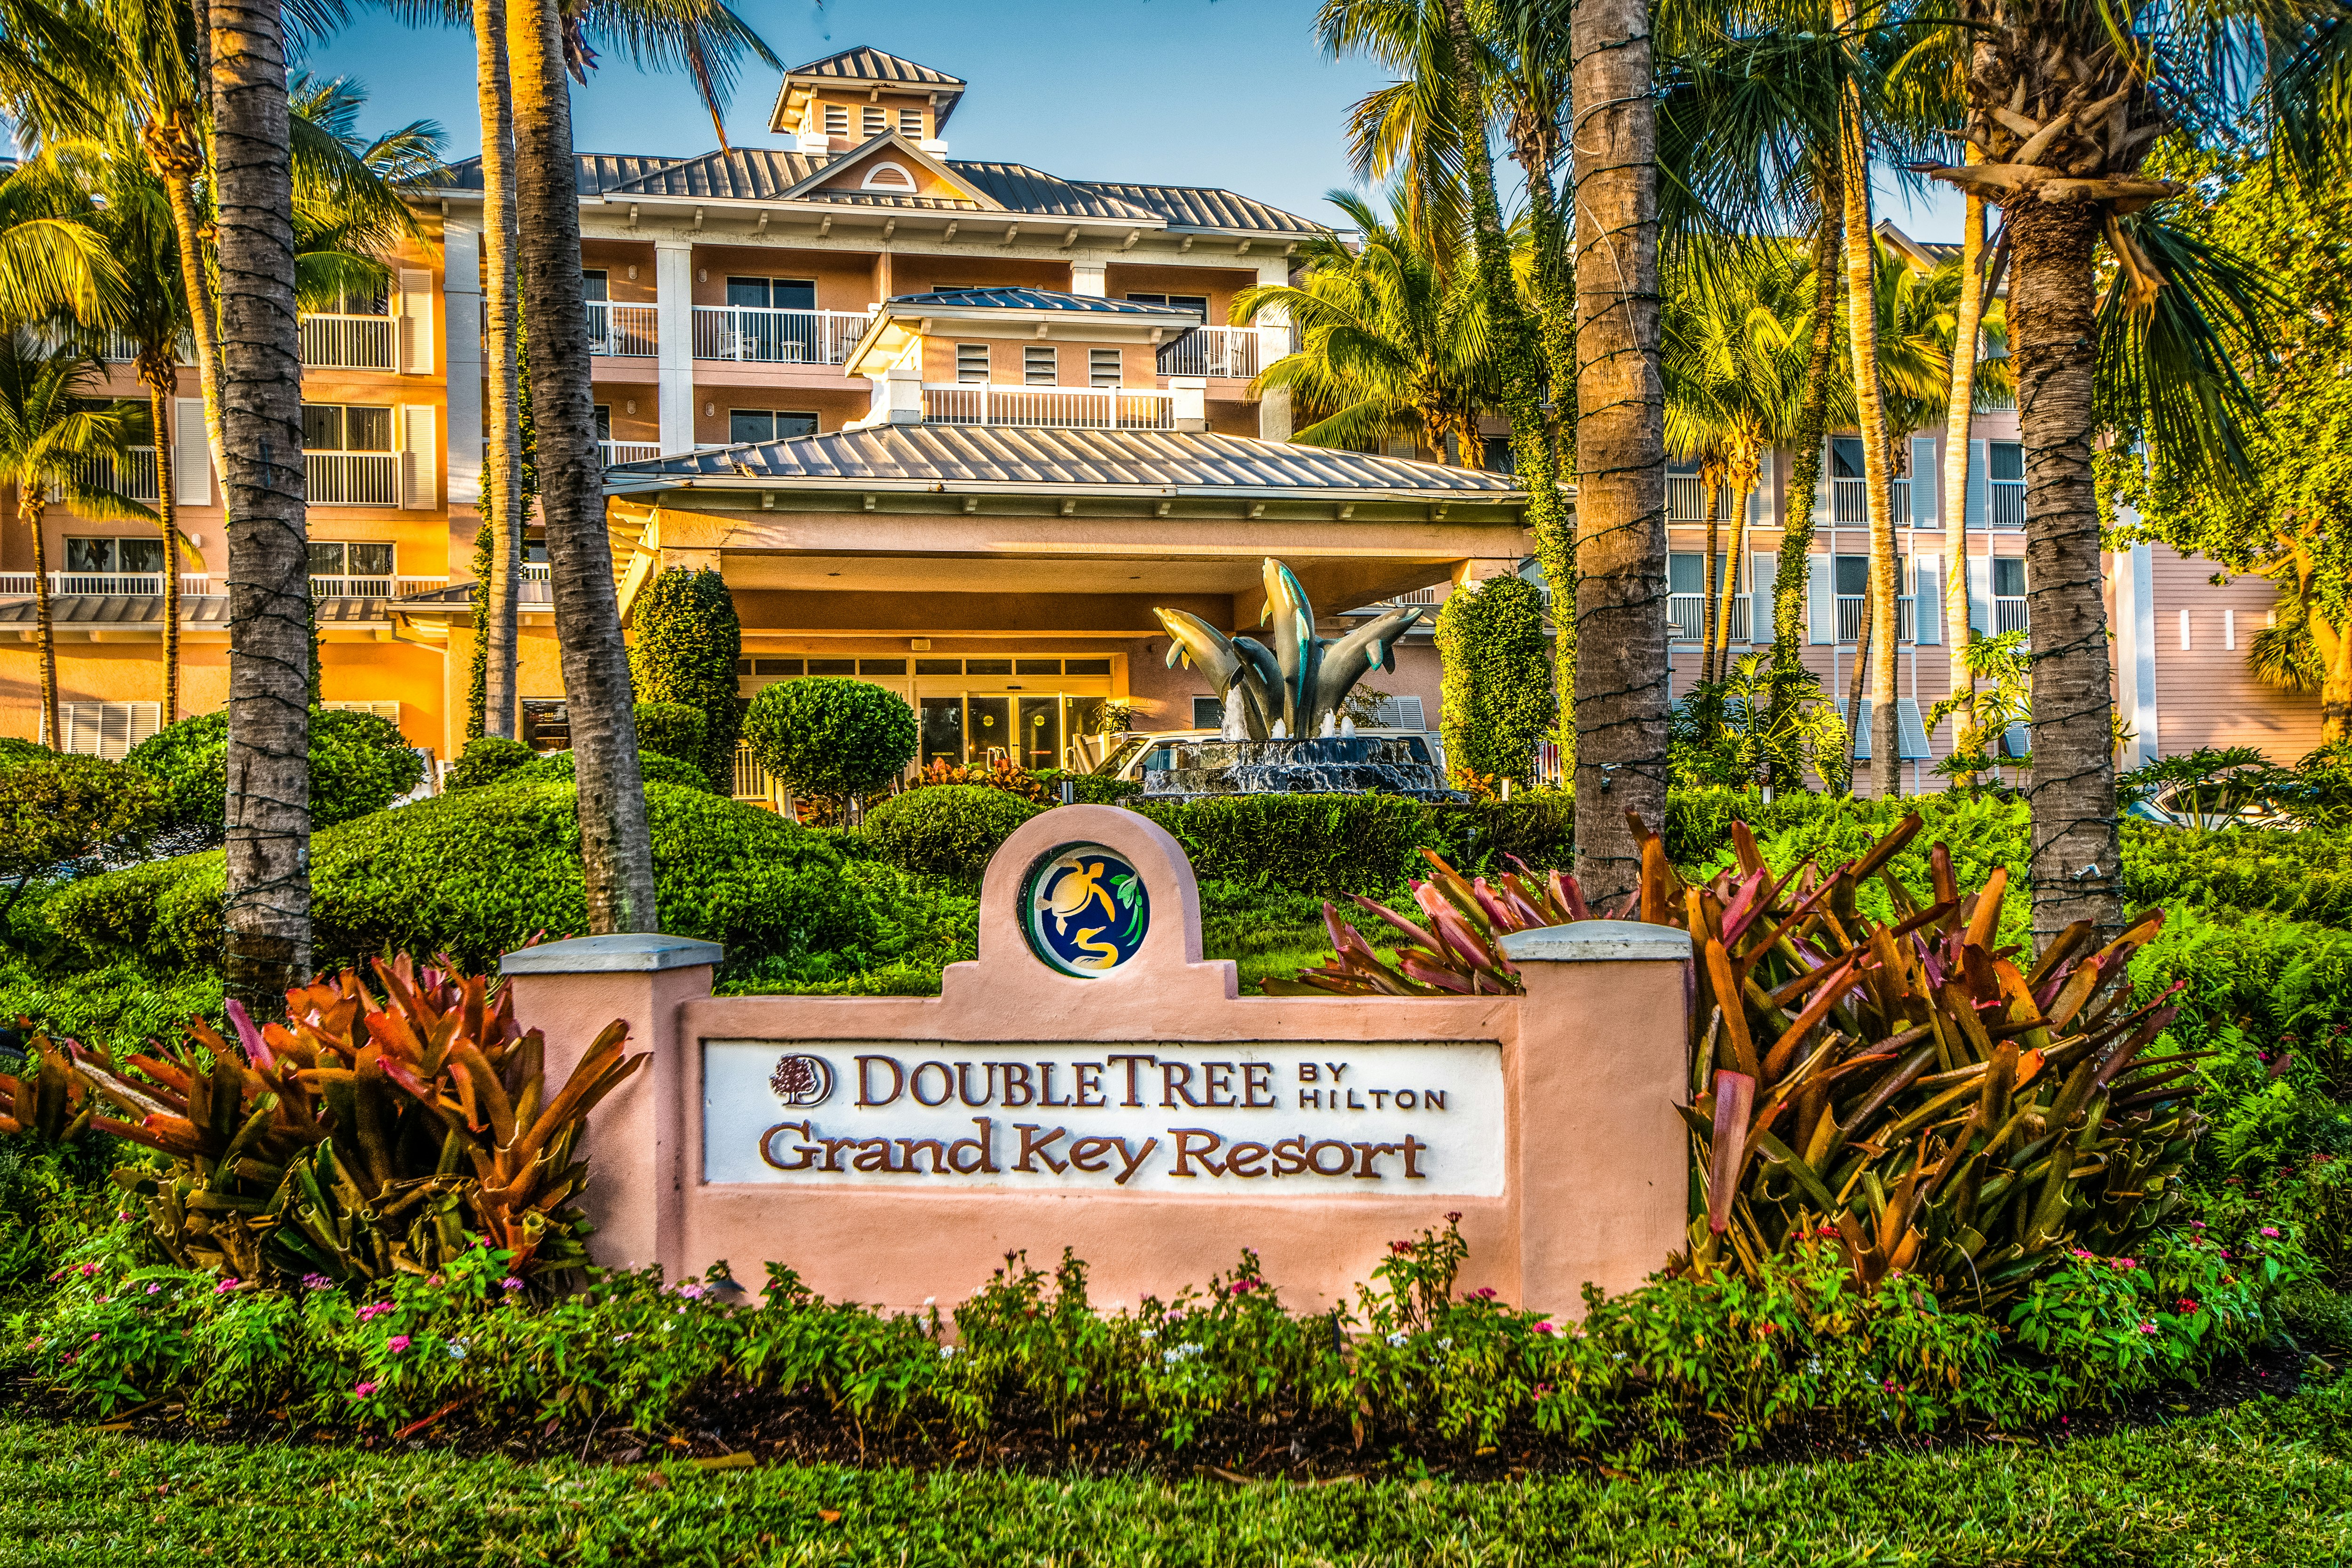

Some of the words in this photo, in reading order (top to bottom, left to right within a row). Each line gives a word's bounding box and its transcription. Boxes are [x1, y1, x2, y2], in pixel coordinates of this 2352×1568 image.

[1298, 1062, 1347, 1082] BY
[1298, 1088, 1446, 1111] HILTON
[758, 1116, 1001, 1175] Grand
[1011, 1122, 1159, 1186] Key
[1167, 1127, 1427, 1179] Resort
